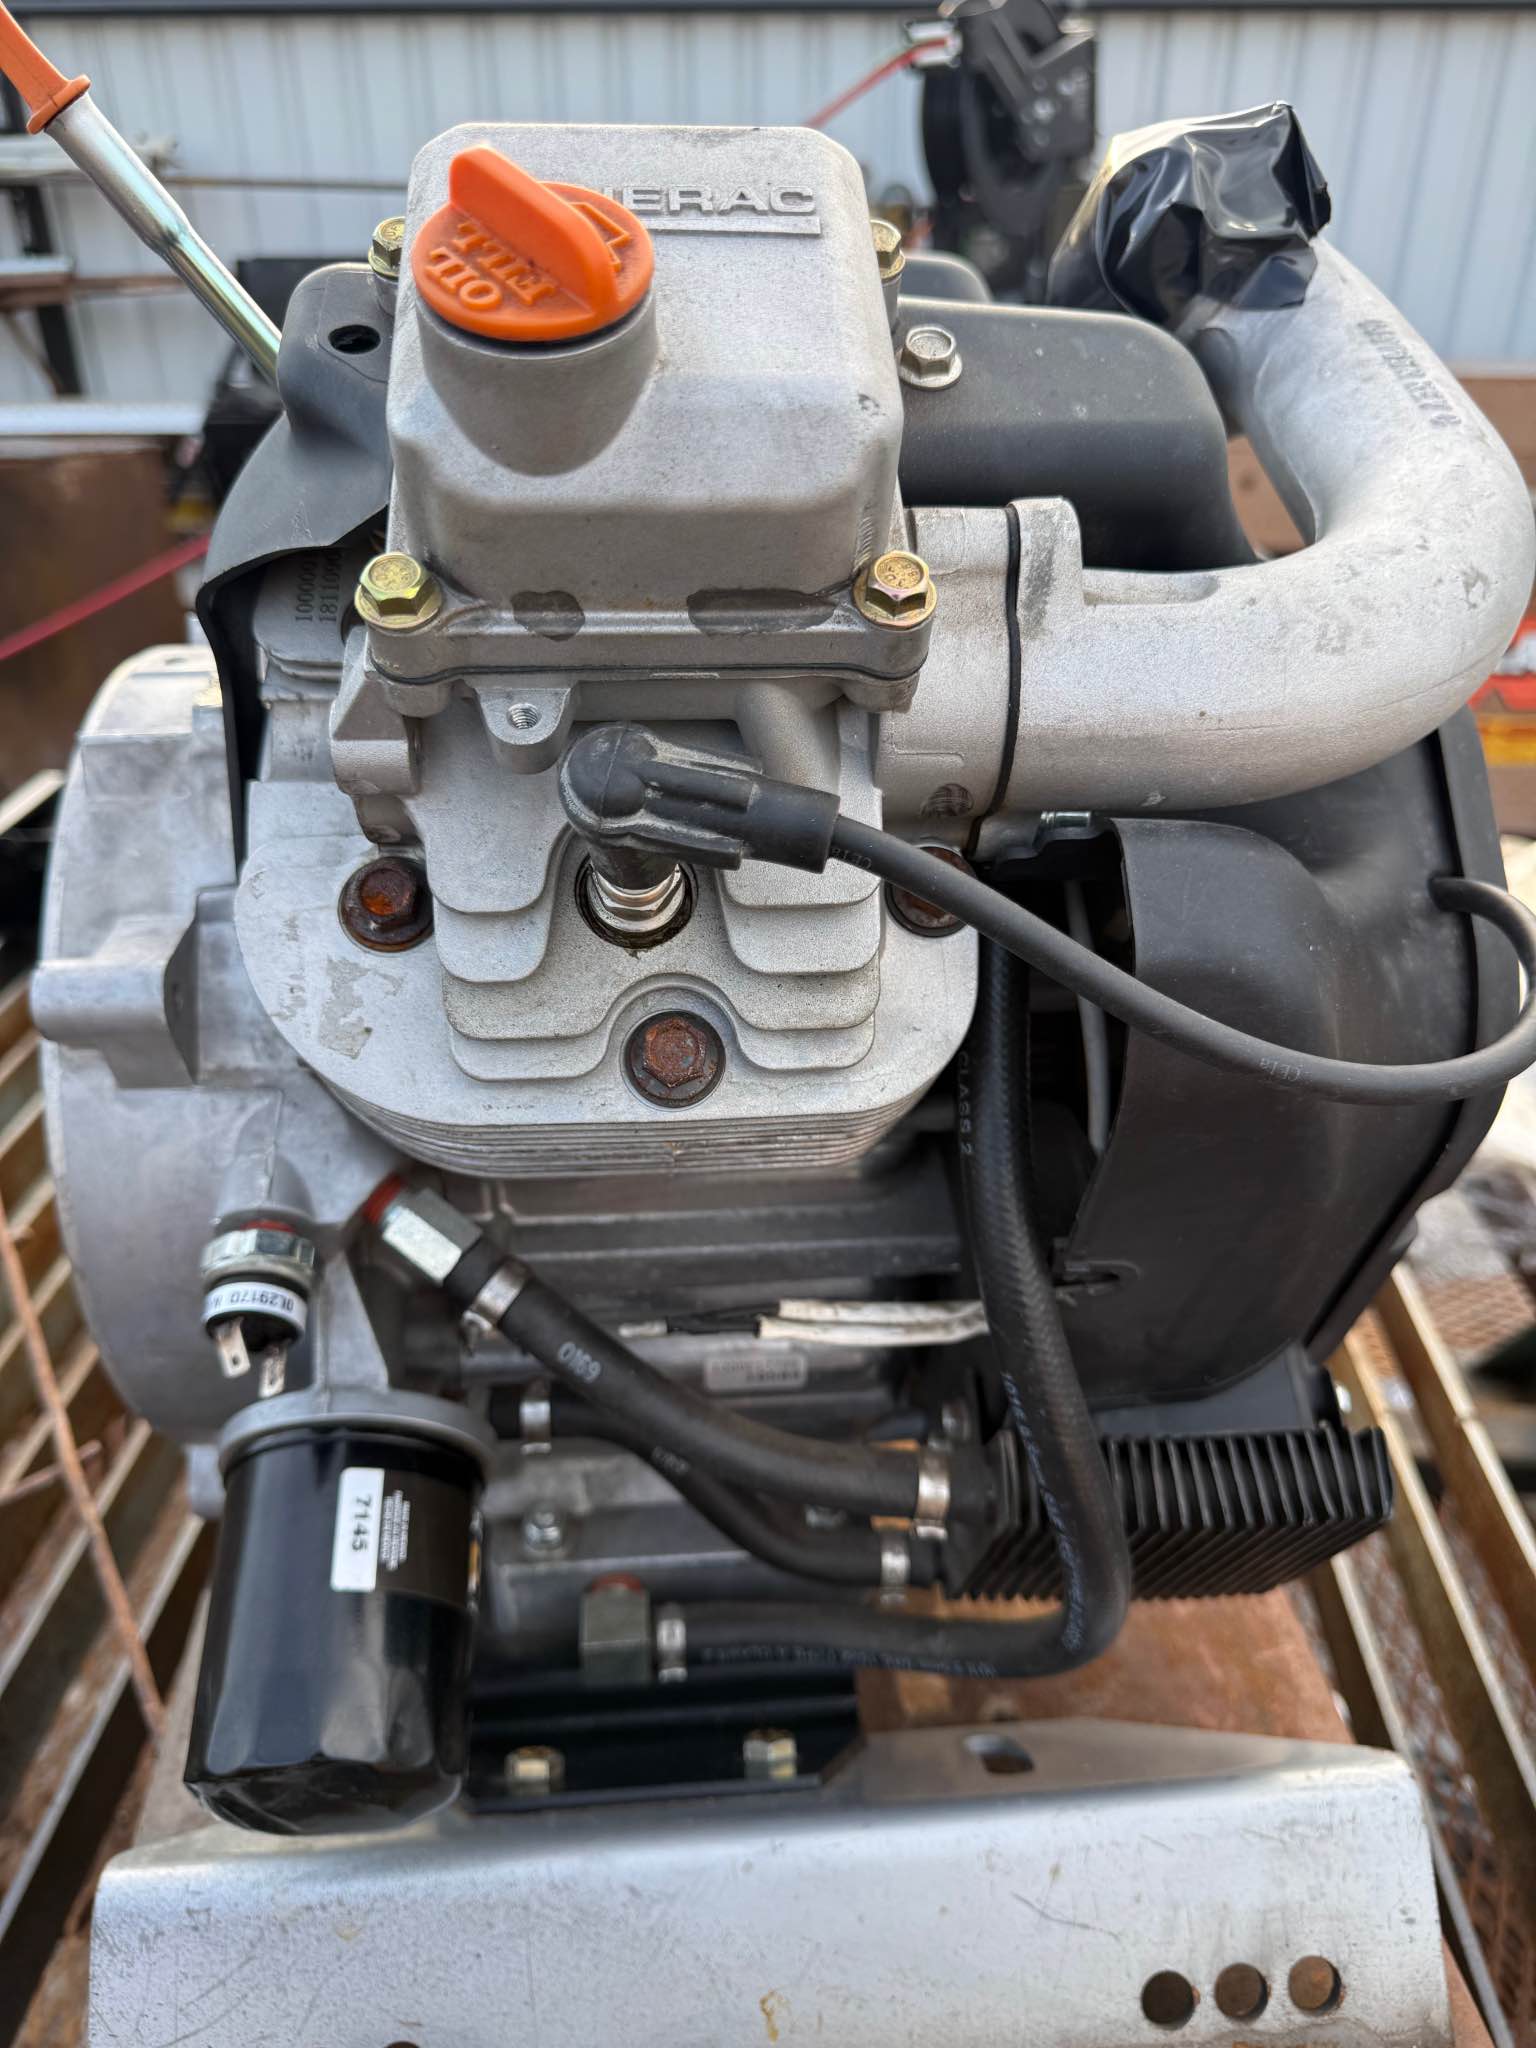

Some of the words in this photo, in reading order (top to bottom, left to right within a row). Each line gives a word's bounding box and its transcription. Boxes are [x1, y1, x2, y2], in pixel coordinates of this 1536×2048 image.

[604, 184, 817, 215] ERAC
[426, 246, 501, 311] OIL
[453, 220, 556, 306] FILL
[958, 1050, 971, 1133] CLASS
[961, 1141, 973, 1155] 2
[351, 1493, 372, 1553] 7145
